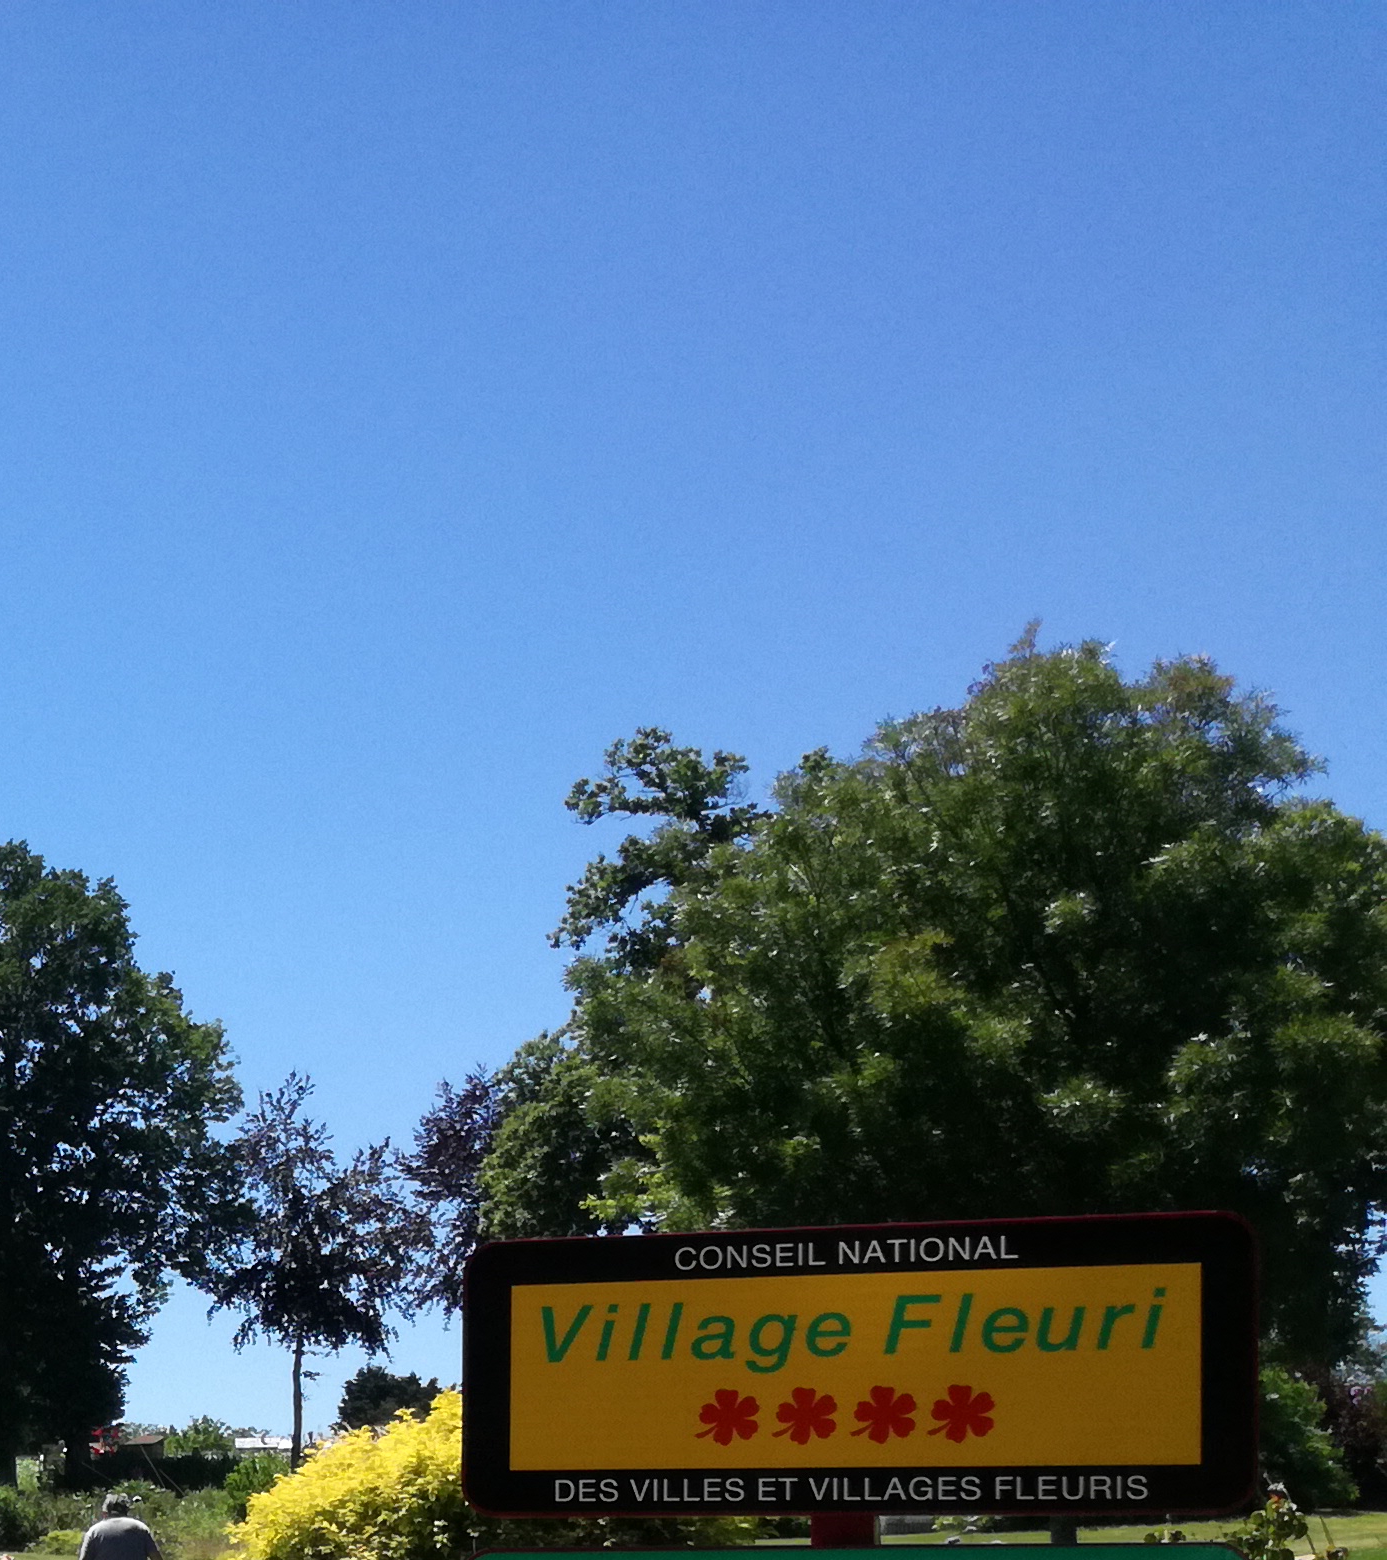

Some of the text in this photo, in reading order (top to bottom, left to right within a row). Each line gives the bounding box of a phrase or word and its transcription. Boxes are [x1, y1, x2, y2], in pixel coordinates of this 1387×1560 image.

[674, 1235, 1019, 1271] CONSEIL NATIONAL
[540, 1287, 1167, 1374] Village Fleuri
[555, 1475, 1149, 1502] DES VILLES ET VILLAGES FLEURIS
